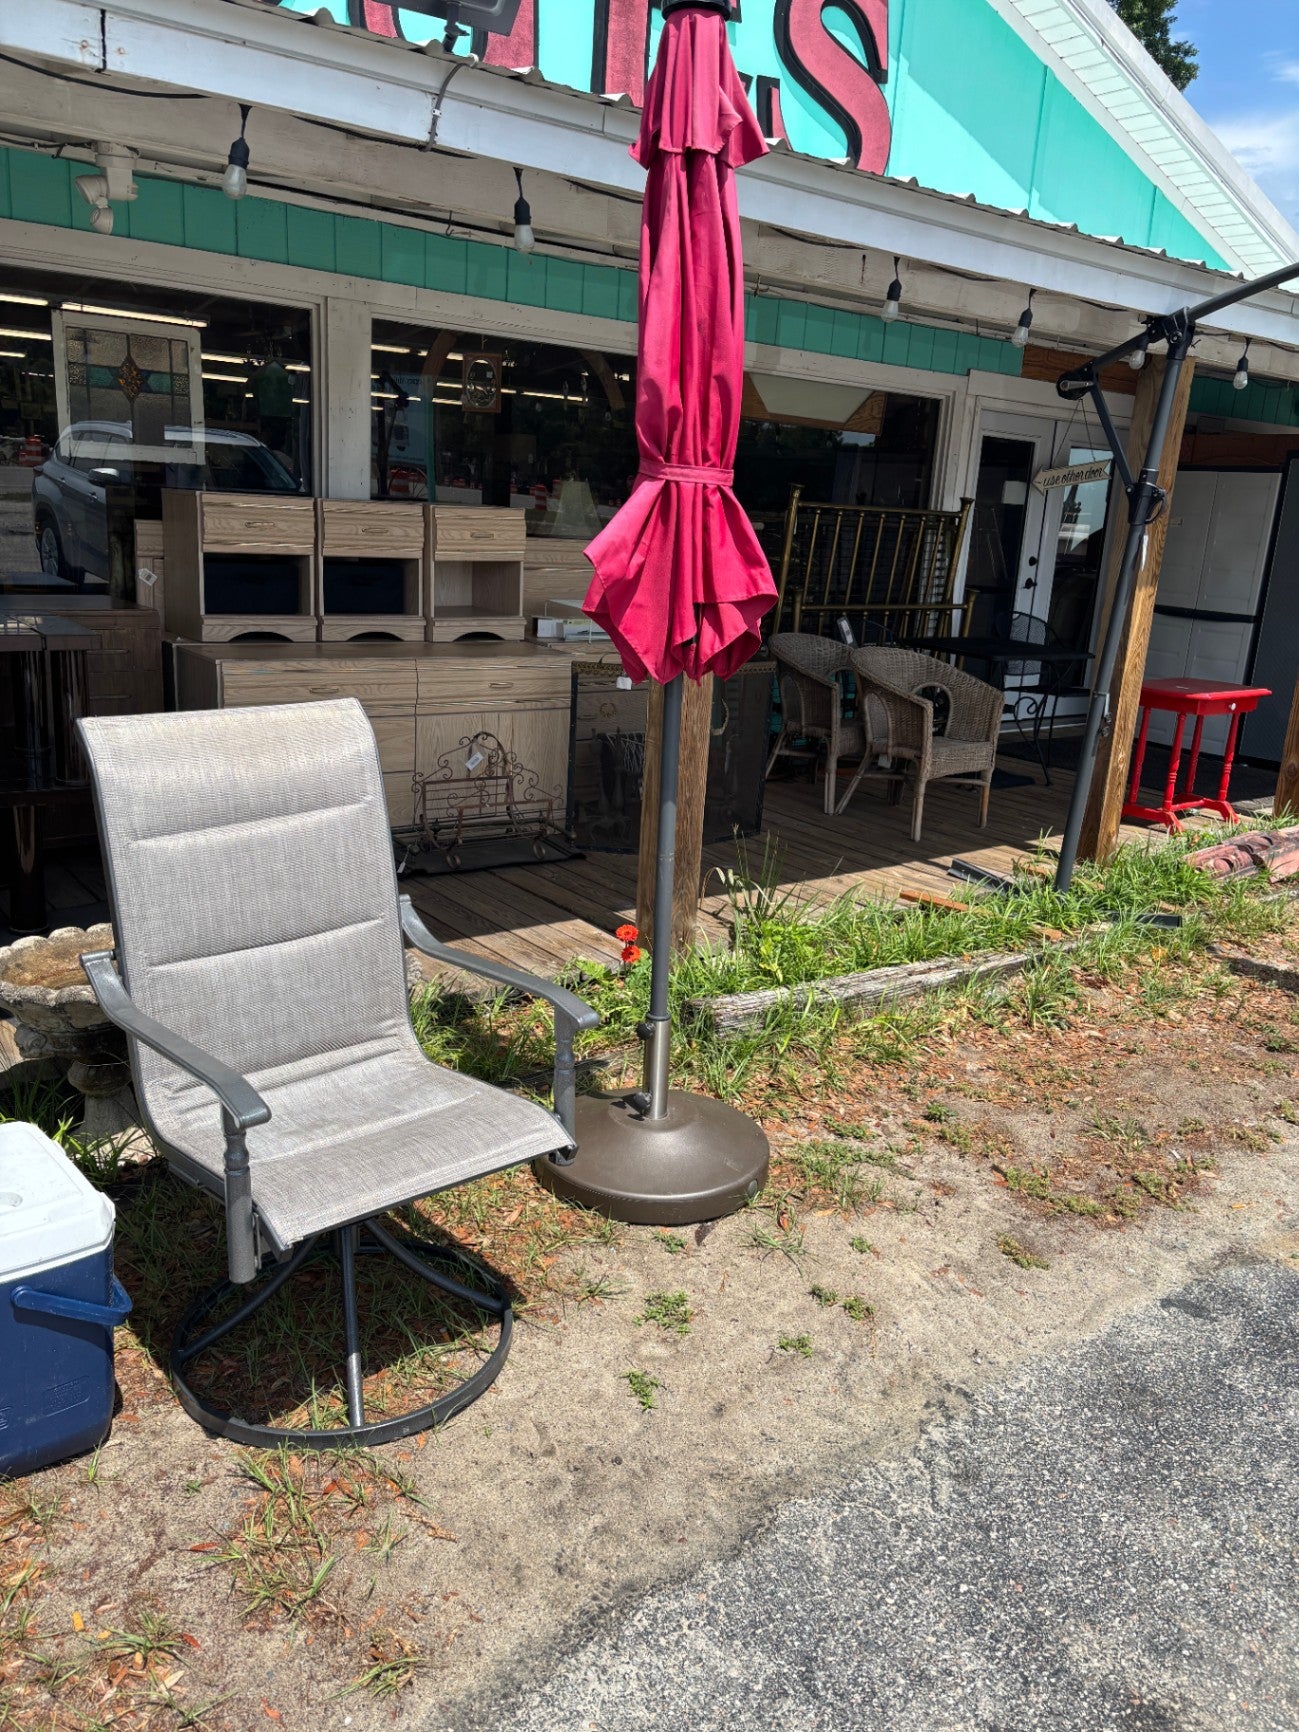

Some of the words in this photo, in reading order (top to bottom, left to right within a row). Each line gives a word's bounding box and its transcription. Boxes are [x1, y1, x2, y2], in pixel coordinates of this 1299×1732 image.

[1043, 475, 1060, 487] use
[1062, 468, 1084, 484] other
[1085, 466, 1103, 480] door
